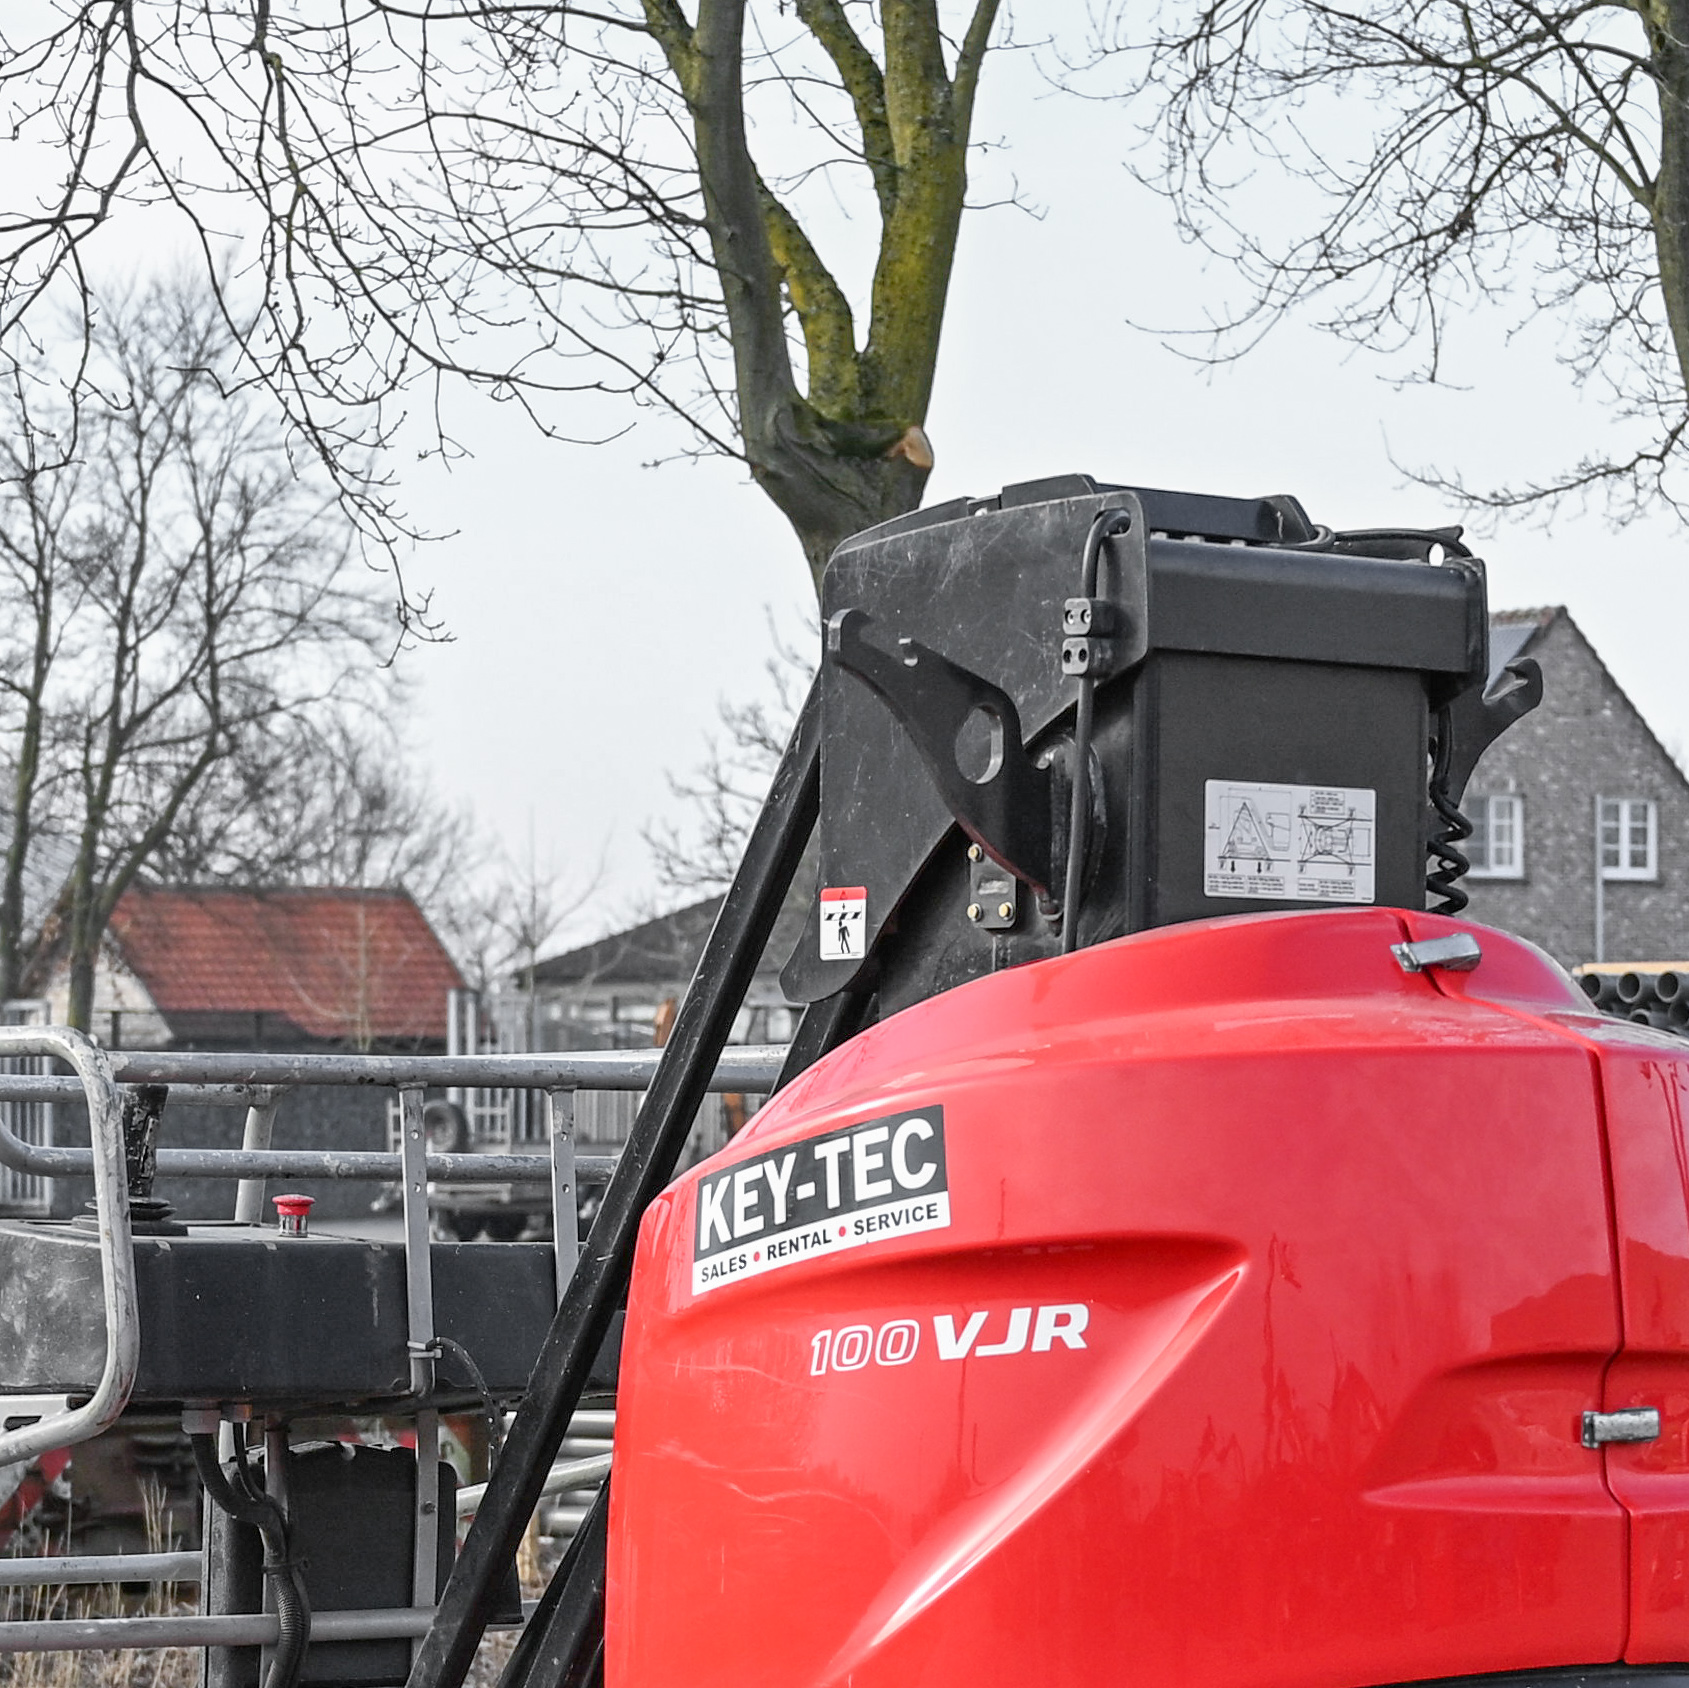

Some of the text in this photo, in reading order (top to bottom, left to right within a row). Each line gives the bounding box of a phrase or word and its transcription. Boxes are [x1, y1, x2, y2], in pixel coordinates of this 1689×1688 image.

[699, 1117, 938, 1251] KEY-TEC
[701, 1202, 938, 1283] SALES RENTAL SERVICE
[810, 1303, 1089, 1376] 100 VJR
